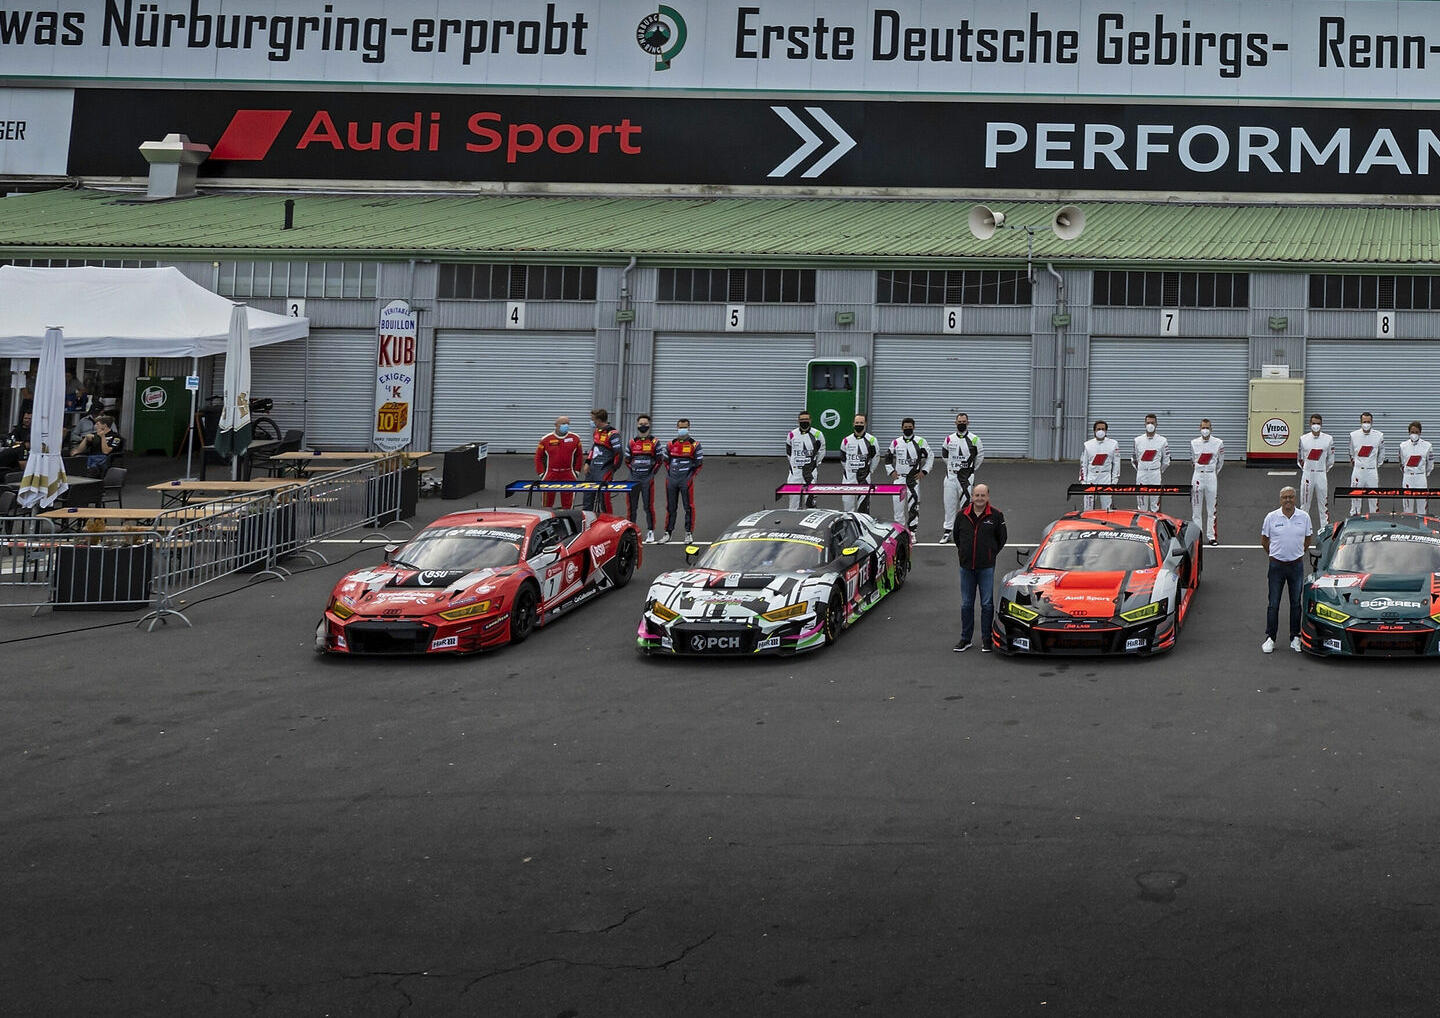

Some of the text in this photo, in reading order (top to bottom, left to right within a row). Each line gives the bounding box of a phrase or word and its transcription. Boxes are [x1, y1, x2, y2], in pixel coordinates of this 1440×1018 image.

[0, 11, 85, 45] was
[736, 7, 854, 60] Erste
[872, 9, 1078, 63] Deutsche
[1097, 13, 1288, 78] Gebirgs-
[296, 111, 643, 163] Audi Sport
[291, 304, 299, 317] 3
[511, 307, 519, 324] 4
[731, 309, 739, 327] 5
[949, 311, 956, 329] 6
[1166, 314, 1173, 331] 7
[380, 319, 415, 330] BOUILLON
[1382, 316, 1389, 334] 8
[378, 334, 415, 368] KUB
[378, 373, 412, 384] EXIGER
[392, 386, 402, 398] K
[1266, 423, 1288, 433] VEEDOL
[1139, 486, 1180, 494] Sport
[790, 533, 823, 543] TURISMO
[1119, 532, 1151, 541] TURISMO
[1029, 576, 1041, 585] 3
[1360, 600, 1421, 609] SCHERER
[708, 637, 739, 648] PCH
